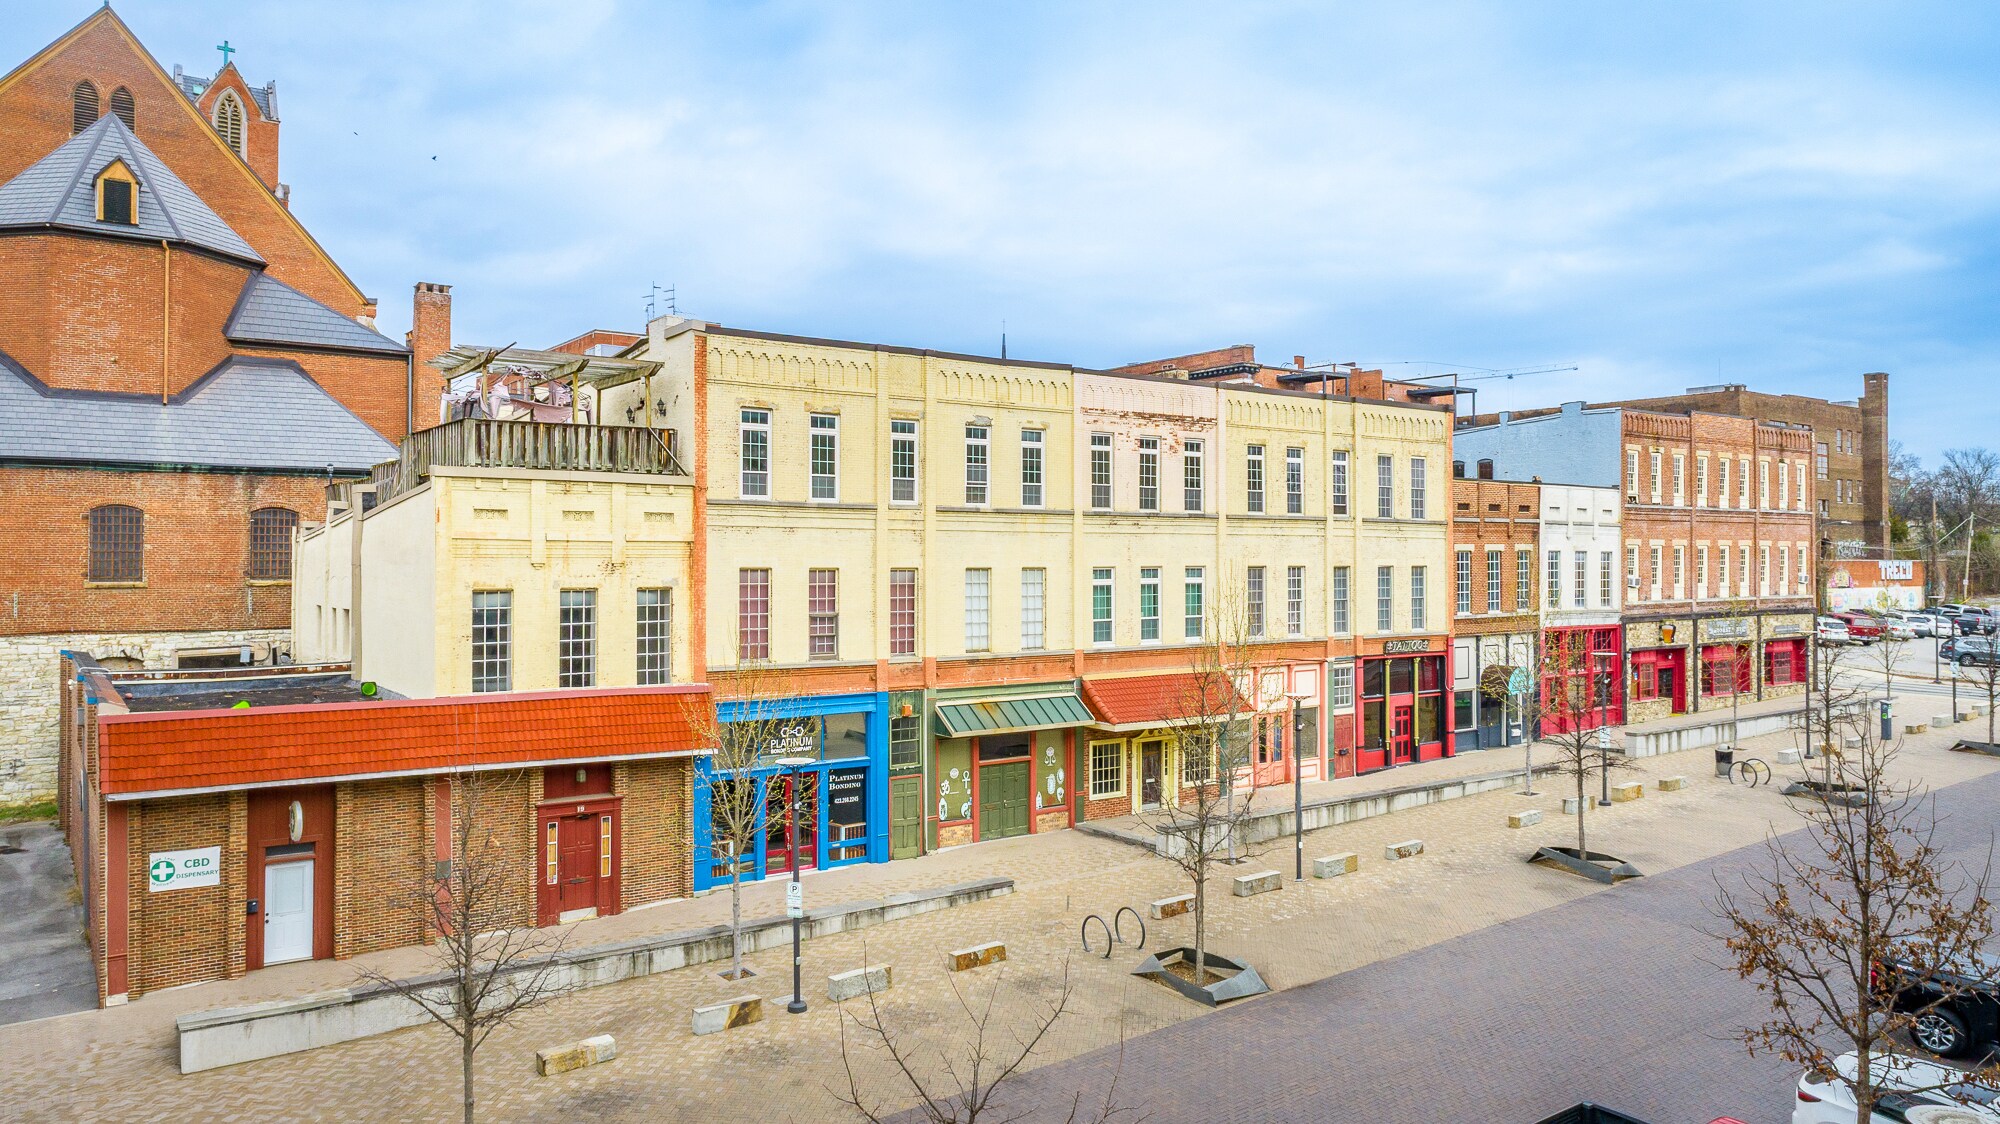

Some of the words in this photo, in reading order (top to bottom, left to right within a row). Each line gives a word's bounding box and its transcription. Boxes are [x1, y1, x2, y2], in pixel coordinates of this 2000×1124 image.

[1393, 640, 1423, 650] TATTOO
[771, 736, 812, 749] PLATINUM
[829, 773, 864, 782] PLATINUM
[829, 782, 861, 790] BONDING
[184, 858, 210, 868] CBD
[176, 869, 219, 879] DISPENSARY
